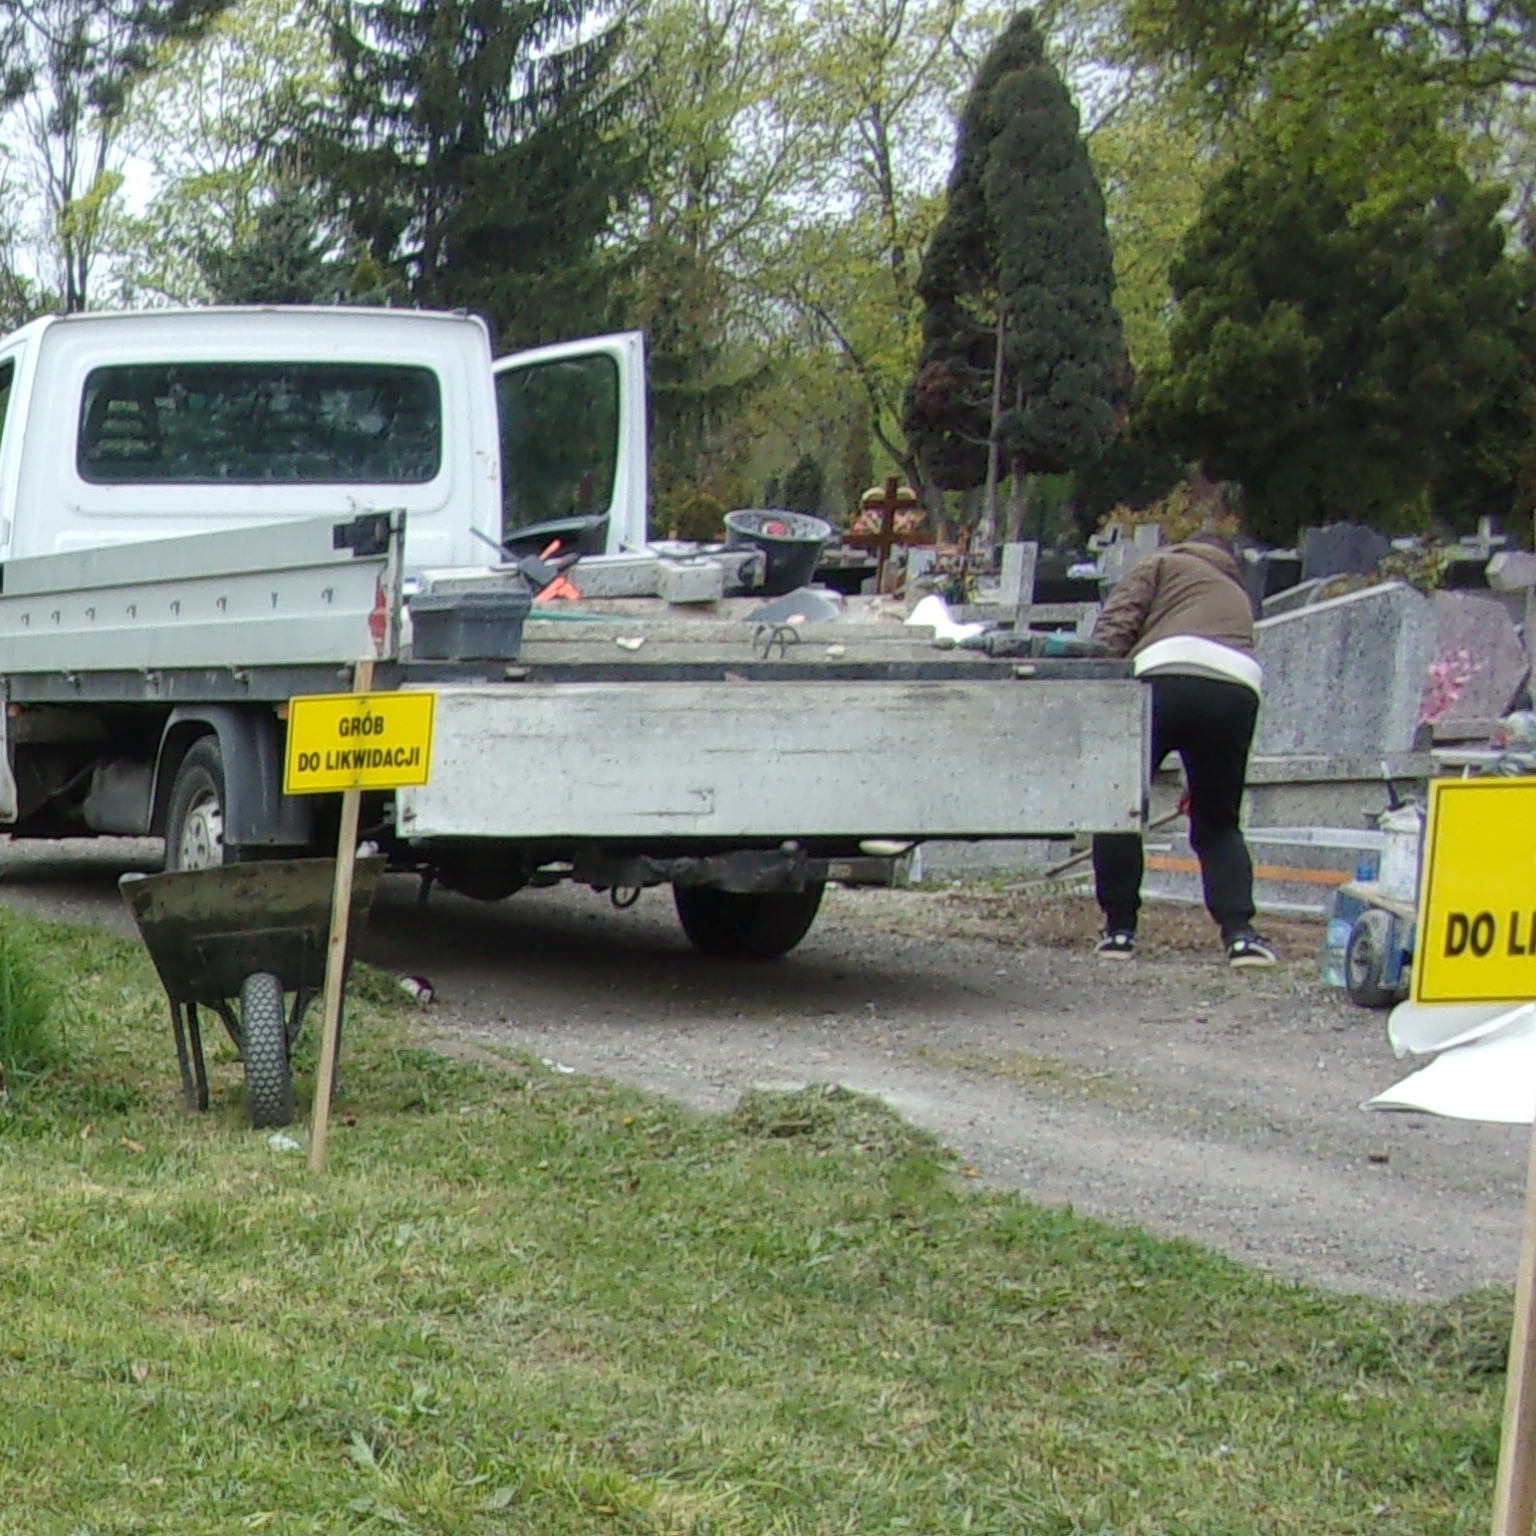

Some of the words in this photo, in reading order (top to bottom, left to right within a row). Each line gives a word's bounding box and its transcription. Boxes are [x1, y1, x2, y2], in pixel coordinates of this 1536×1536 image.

[339, 711, 384, 738] GRÓB
[298, 752, 320, 772] DO
[325, 747, 420, 771] LIKWIDACJI
[1444, 910, 1495, 958] DO
